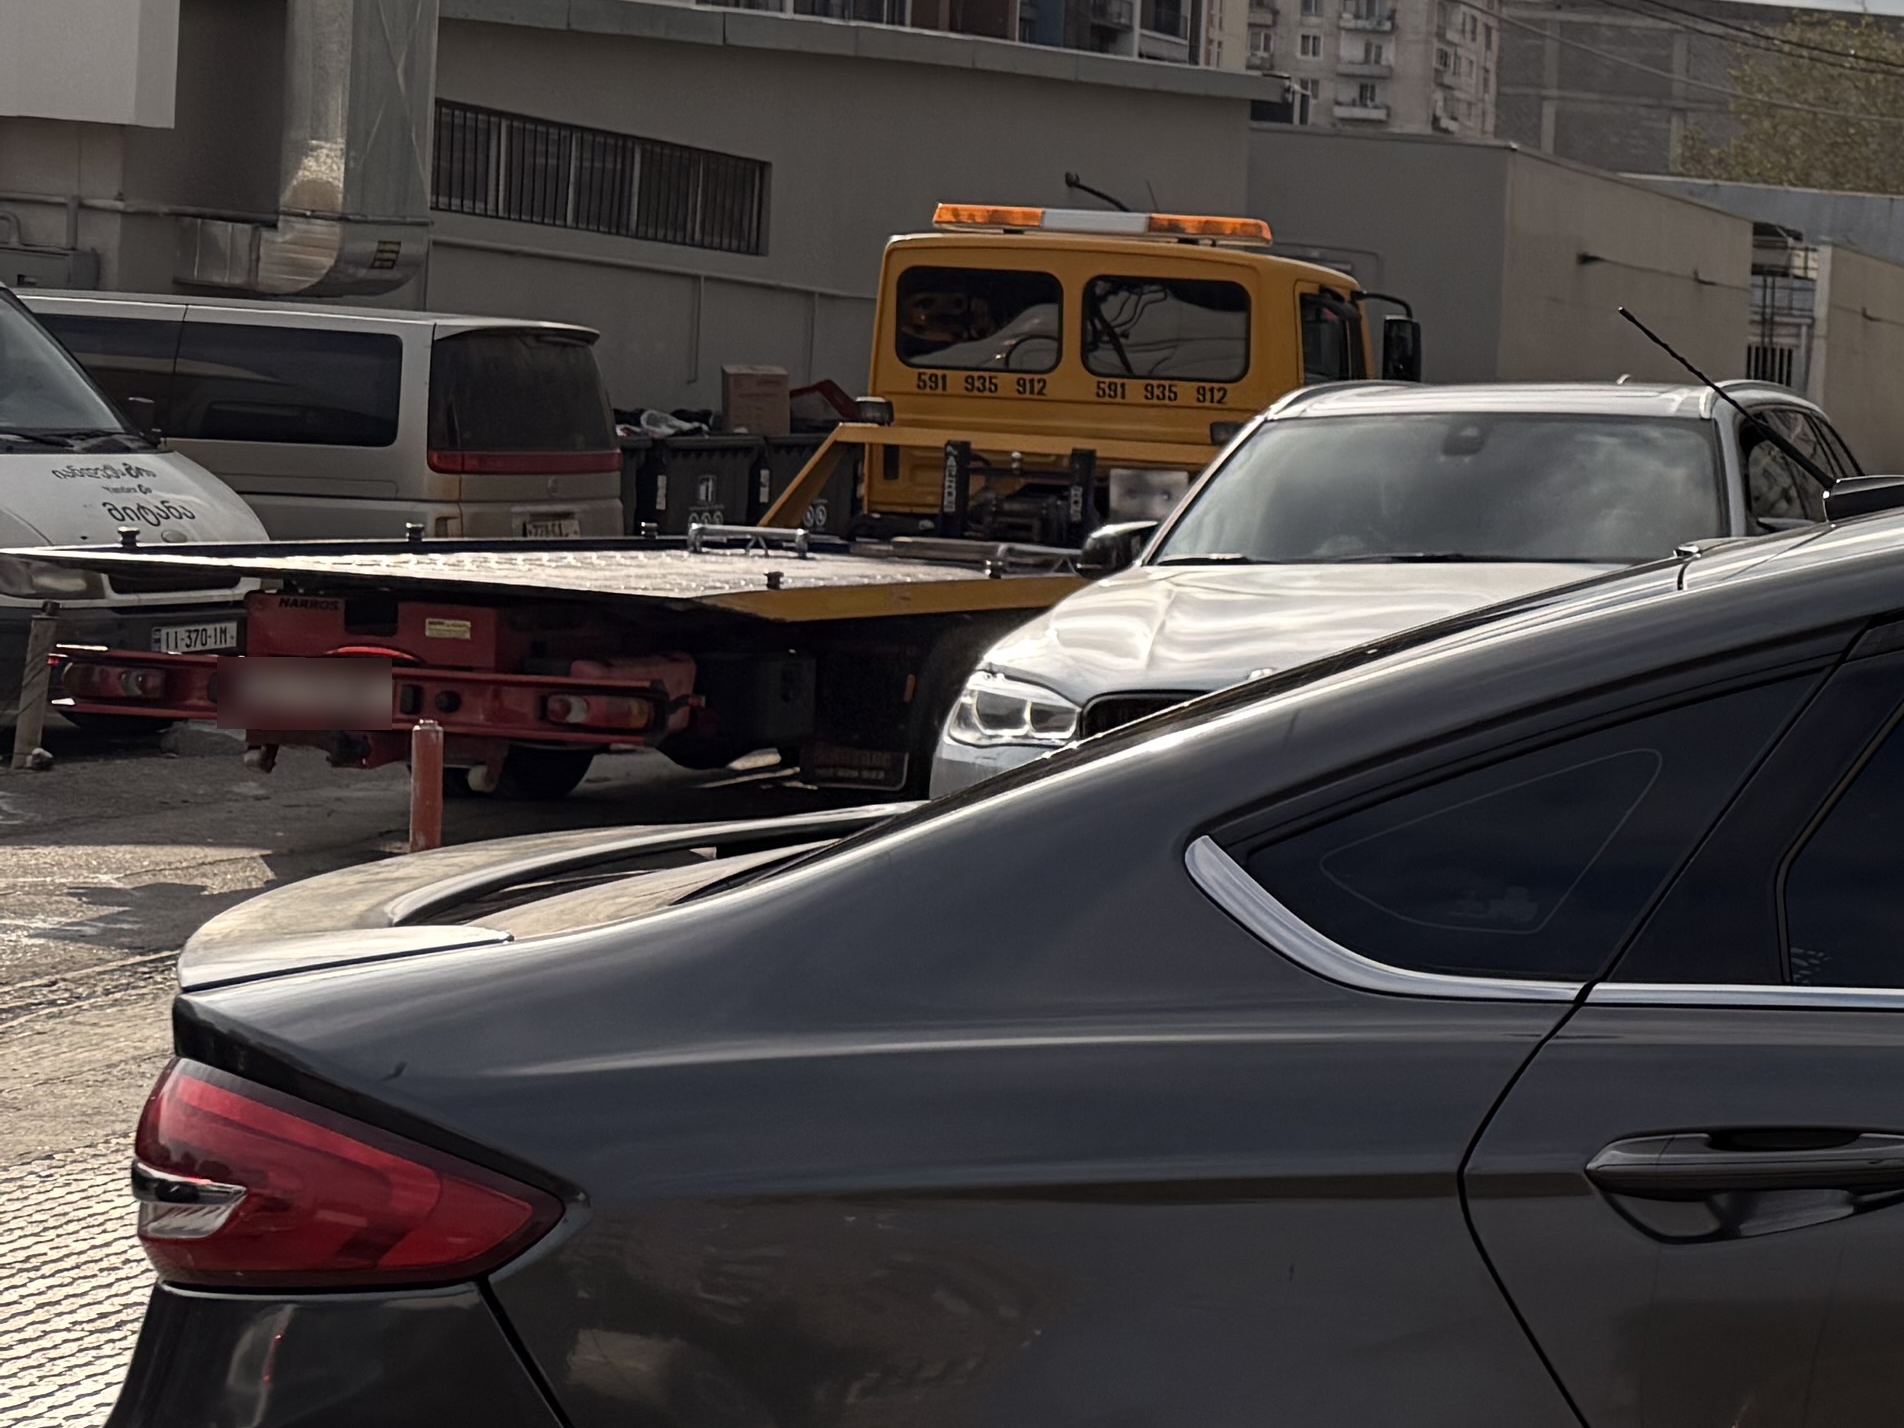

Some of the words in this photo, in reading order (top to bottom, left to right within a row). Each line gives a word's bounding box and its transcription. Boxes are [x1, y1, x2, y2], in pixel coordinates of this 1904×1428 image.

[916, 373, 948, 391] 591
[964, 375, 998, 394] 935
[1016, 378, 1047, 397] 912
[1095, 381, 1126, 400] 591
[1144, 384, 1178, 402] 935
[1196, 386, 1228, 405] 912
[101, 500, 196, 527] მიტანა
